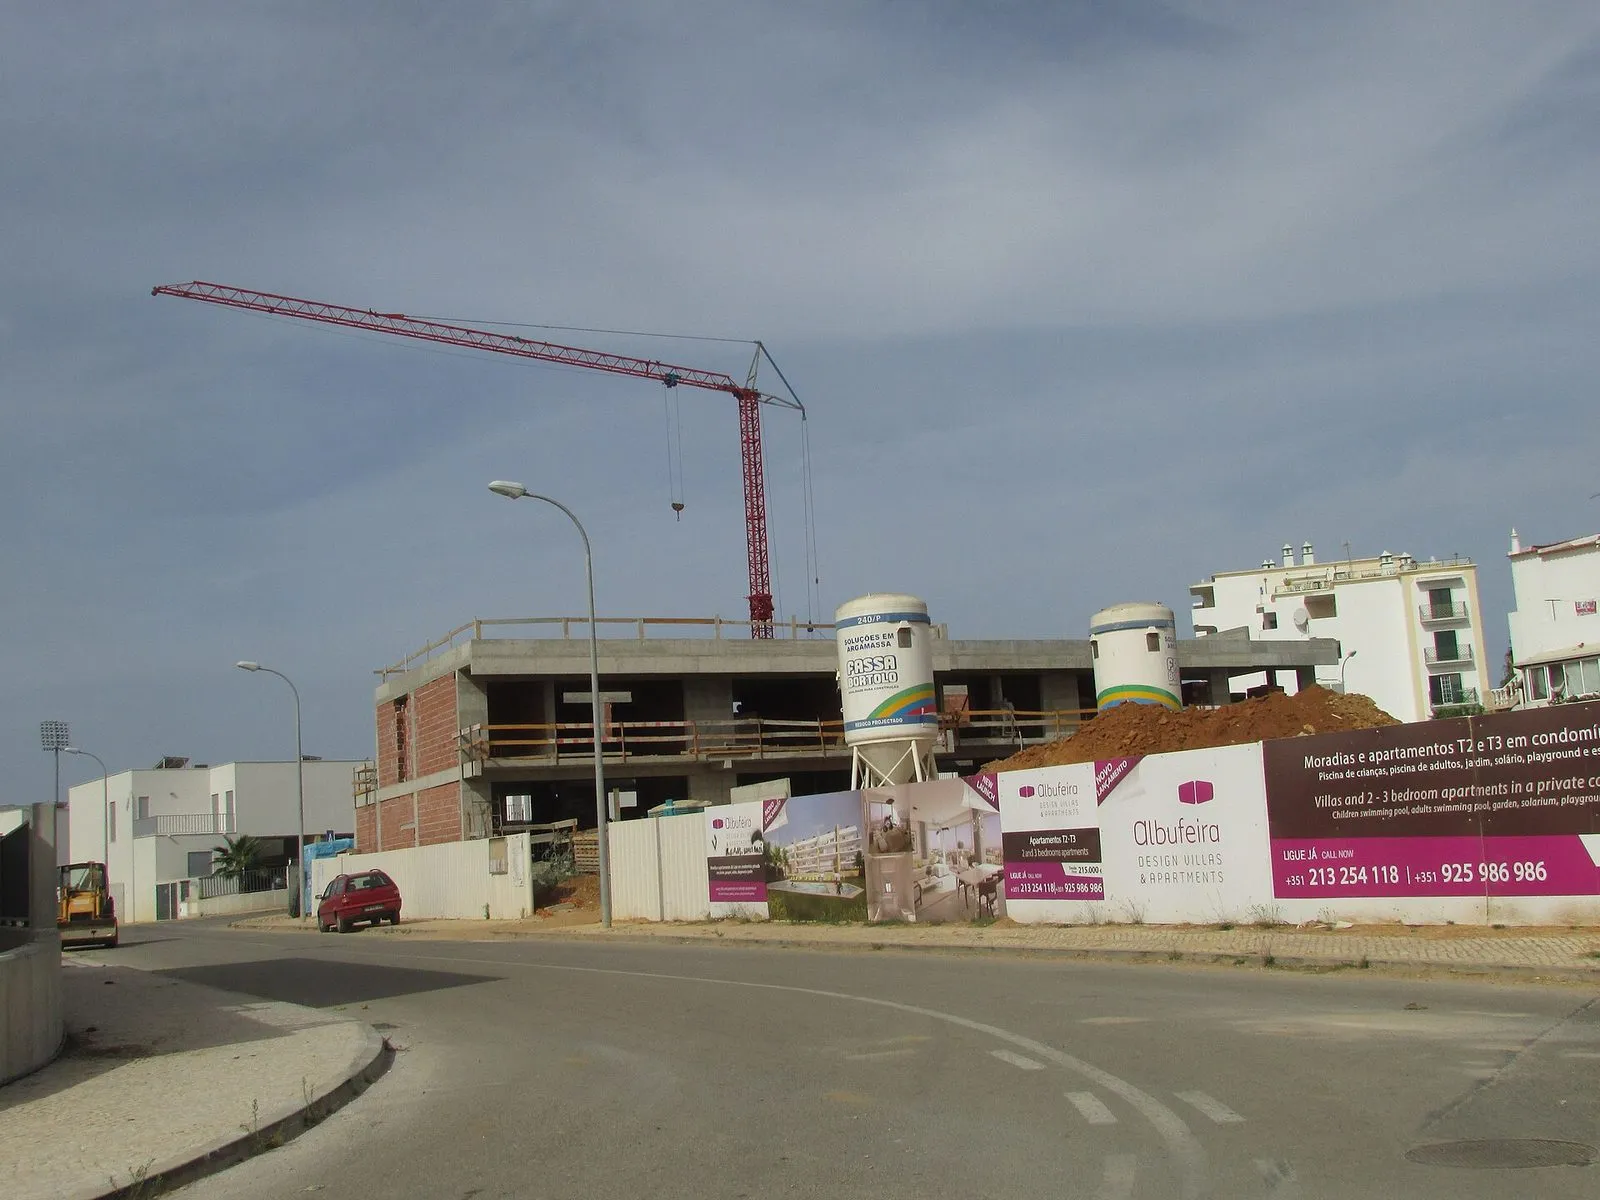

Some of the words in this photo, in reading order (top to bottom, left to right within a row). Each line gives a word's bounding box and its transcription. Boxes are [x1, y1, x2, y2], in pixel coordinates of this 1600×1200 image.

[858, 615, 881, 625] 240/P
[844, 634, 880, 646] SOLUÇÕES
[882, 632, 894, 640] EM
[846, 641, 892, 652] ARGAMASSA
[846, 654, 897, 676] FASSA
[848, 671, 898, 688] BORTOLO
[1304, 752, 1355, 768] Moradias
[1358, 752, 1365, 762] e
[1368, 742, 1454, 764] apartamentos
[1457, 739, 1473, 752] T2
[1478, 740, 1484, 752] e
[1487, 736, 1502, 750] T3
[1506, 736, 1527, 749] em
[1319, 770, 1344, 781] Piscina
[1346, 768, 1355, 778] de
[1356, 766, 1388, 778] crianças,
[1390, 764, 1416, 776] piscina
[1418, 762, 1428, 772] de
[1430, 758, 1464, 770] adultos,
[1494, 754, 1525, 766] solário,
[1528, 747, 1580, 764] playground
[1584, 748, 1589, 756] e
[1096, 763, 1113, 784] NOVO
[1096, 760, 1128, 796] LANÇAMENTO
[982, 775, 994, 788] NEW
[976, 780, 996, 802] LAUNCH
[1315, 794, 1342, 808] Villas
[1344, 792, 1364, 806] and
[1368, 792, 1373, 804] 2
[1382, 790, 1388, 802] 3
[1392, 788, 1438, 802] bedroom
[1442, 782, 1508, 800] apartments
[1512, 780, 1522, 794] in
[1526, 782, 1533, 792] a
[1537, 776, 1584, 794] private
[1332, 810, 1358, 819] Children
[1360, 807, 1392, 818] swimming
[1394, 806, 1410, 816] pool,
[1412, 804, 1432, 814] adults
[1434, 802, 1472, 812] swimming
[1474, 801, 1490, 812] pool,
[1492, 800, 1520, 811] garden,
[1521, 796, 1558, 808] solarium,
[1030, 836, 1062, 846] Apartamentos
[1026, 848, 1034, 857] and
[1062, 847, 1088, 858] apartments
[1284, 850, 1306, 860] LIGUE
[1308, 846, 1318, 860] JÁ
[1322, 850, 1337, 860] CALL
[1338, 850, 1354, 858] NOW
[1138, 855, 1178, 868] DESIGN
[1184, 853, 1223, 866] VILLAS
[1078, 866, 1098, 874] 215.000
[1140, 873, 1146, 884] &
[1150, 871, 1224, 884] APARTMENTS
[1286, 876, 1304, 886] +351
[1309, 868, 1336, 886] 213
[1340, 866, 1368, 885] 254
[1372, 866, 1399, 884] 118
[1414, 872, 1437, 883] +351
[1441, 863, 1474, 883] 925
[1478, 862, 1510, 882] 986
[1513, 861, 1547, 882] 986
[1020, 883, 1031, 892] 213
[1032, 883, 1042, 892] 254
[1044, 883, 1054, 892] 118
[1064, 883, 1076, 892] 925
[1076, 883, 1088, 892] 986
[1090, 883, 1102, 892] 986
